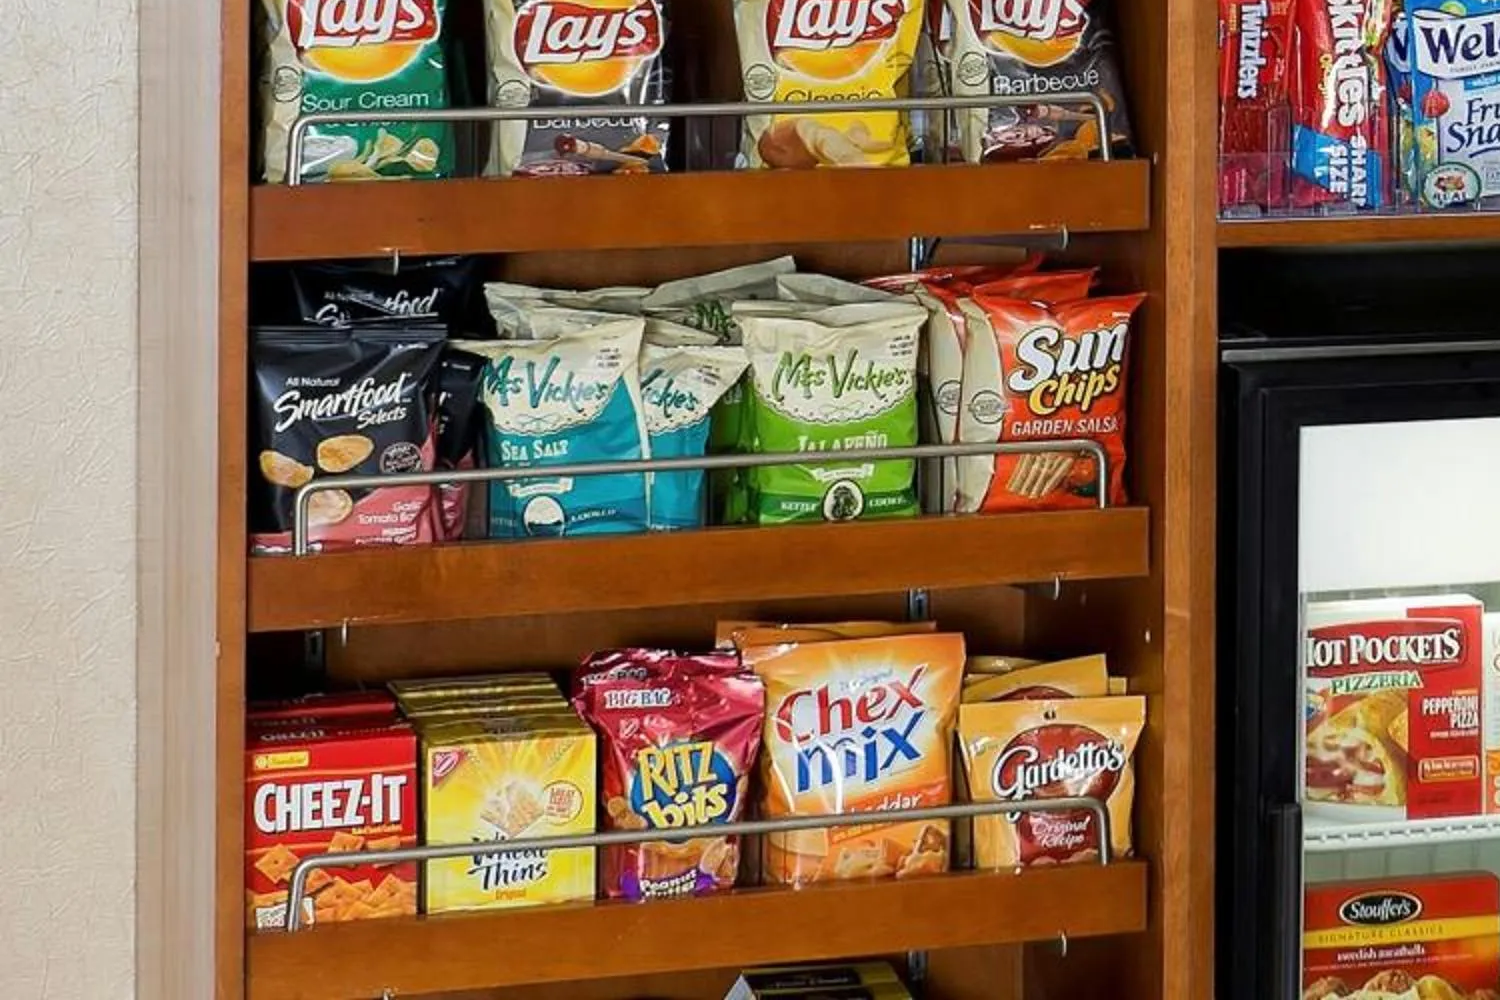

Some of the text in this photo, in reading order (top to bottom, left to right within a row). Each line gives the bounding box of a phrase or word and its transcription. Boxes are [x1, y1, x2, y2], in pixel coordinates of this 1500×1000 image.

[1237, 0, 1269, 99] Twizzlers
[303, 90, 430, 112] Sour Cream
[993, 67, 1101, 95] Barbecue
[1328, 144, 1345, 195] SIZE
[301, 376, 341, 388] Natural
[827, 347, 909, 401] Vickie's
[1007, 323, 1130, 393] Sun
[273, 373, 403, 433] Smartfood
[524, 355, 611, 410] Vickie's
[1029, 360, 1121, 416] Chips
[357, 406, 407, 430] Selects
[1011, 417, 1075, 436] GARDEN
[1348, 628, 1461, 665] POCKETS
[607, 689, 671, 708] BIG BAG
[775, 662, 930, 745] Chex
[1329, 671, 1422, 695] PIZZERIA
[1422, 695, 1479, 717] PEPPERONI
[1451, 710, 1479, 730] PIZZA
[638, 741, 718, 801] RITZ
[797, 710, 927, 794] mix
[254, 772, 408, 834] CHEEZ-IT
[992, 738, 1126, 822] Gardetto's
[642, 782, 729, 830] bits
[467, 858, 549, 893] Thins
[1349, 896, 1413, 921] Stouffer's
